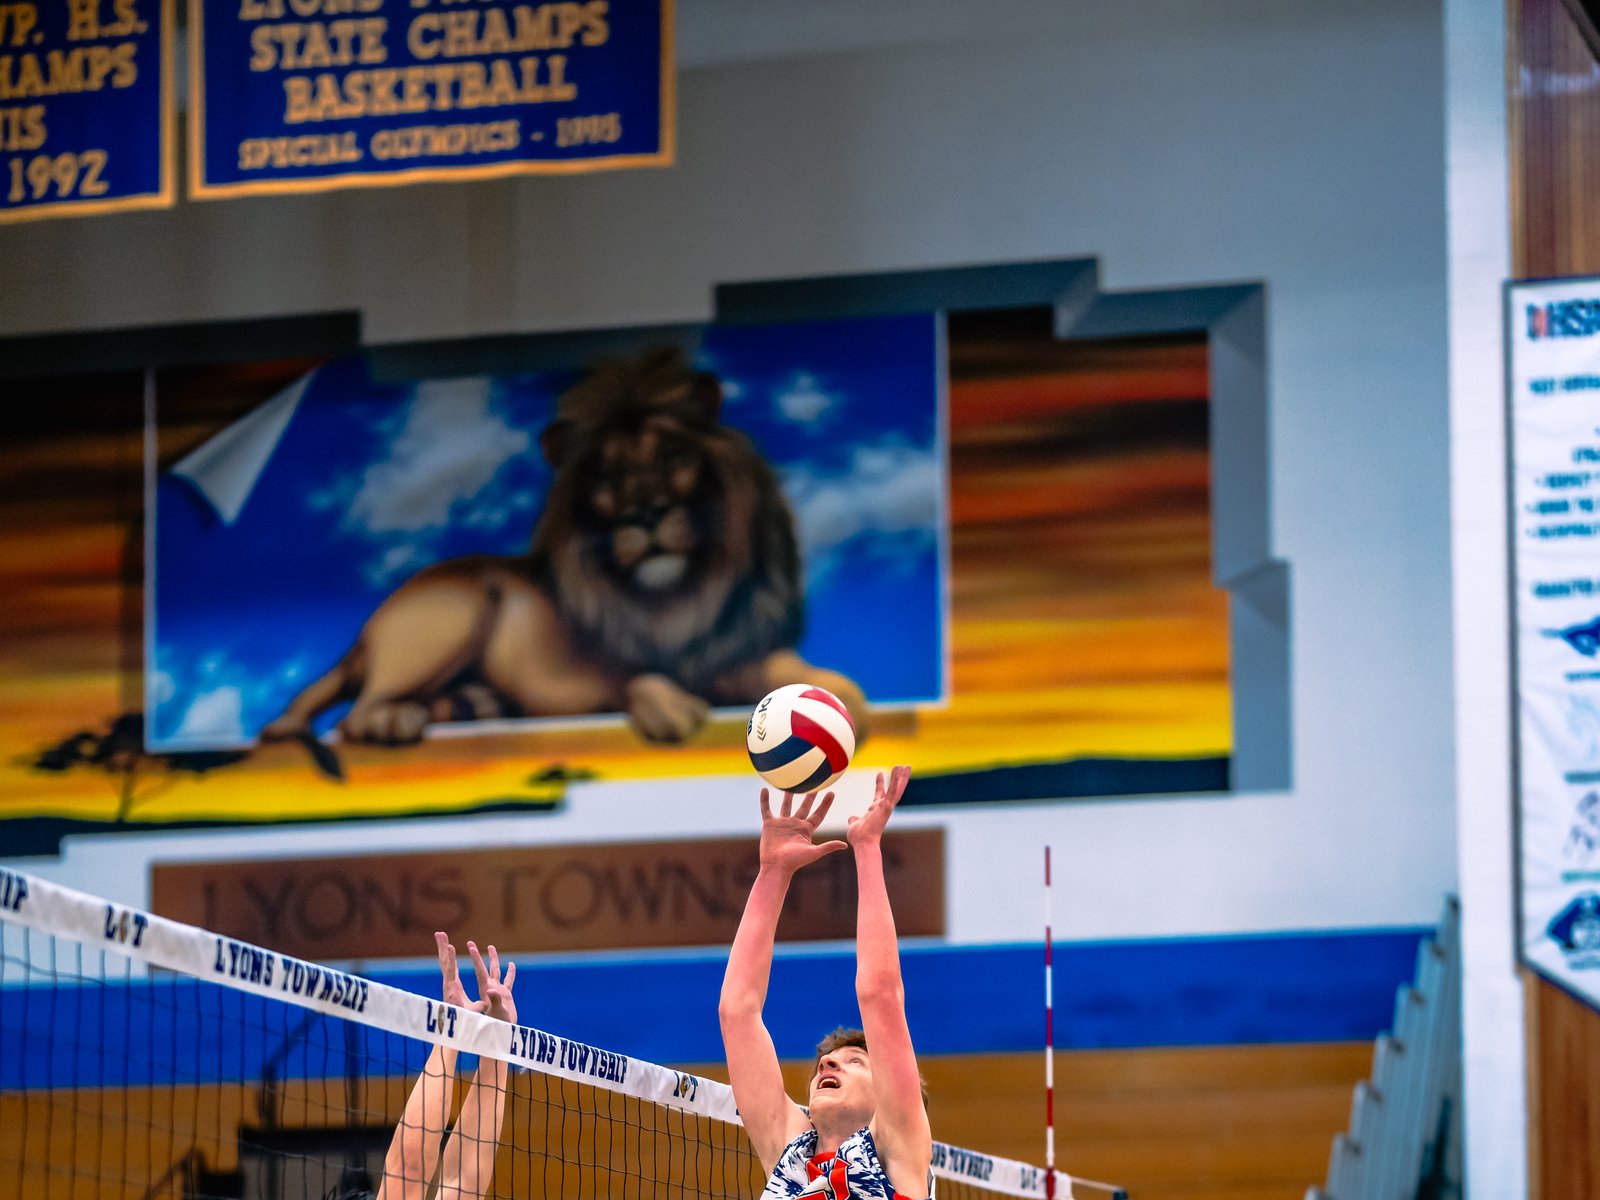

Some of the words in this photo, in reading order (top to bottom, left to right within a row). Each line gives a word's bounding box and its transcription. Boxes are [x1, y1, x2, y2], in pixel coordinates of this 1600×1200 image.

[249, 17, 388, 71] STATE
[407, 2, 609, 60] CHAMPS
[283, 55, 577, 124] BASKETBALL
[8, 149, 109, 202] 1992
[214, 938, 274, 987] LYONS
[510, 1025, 556, 1064] LYONS
[559, 1038, 628, 1084] TOWNSHIP
